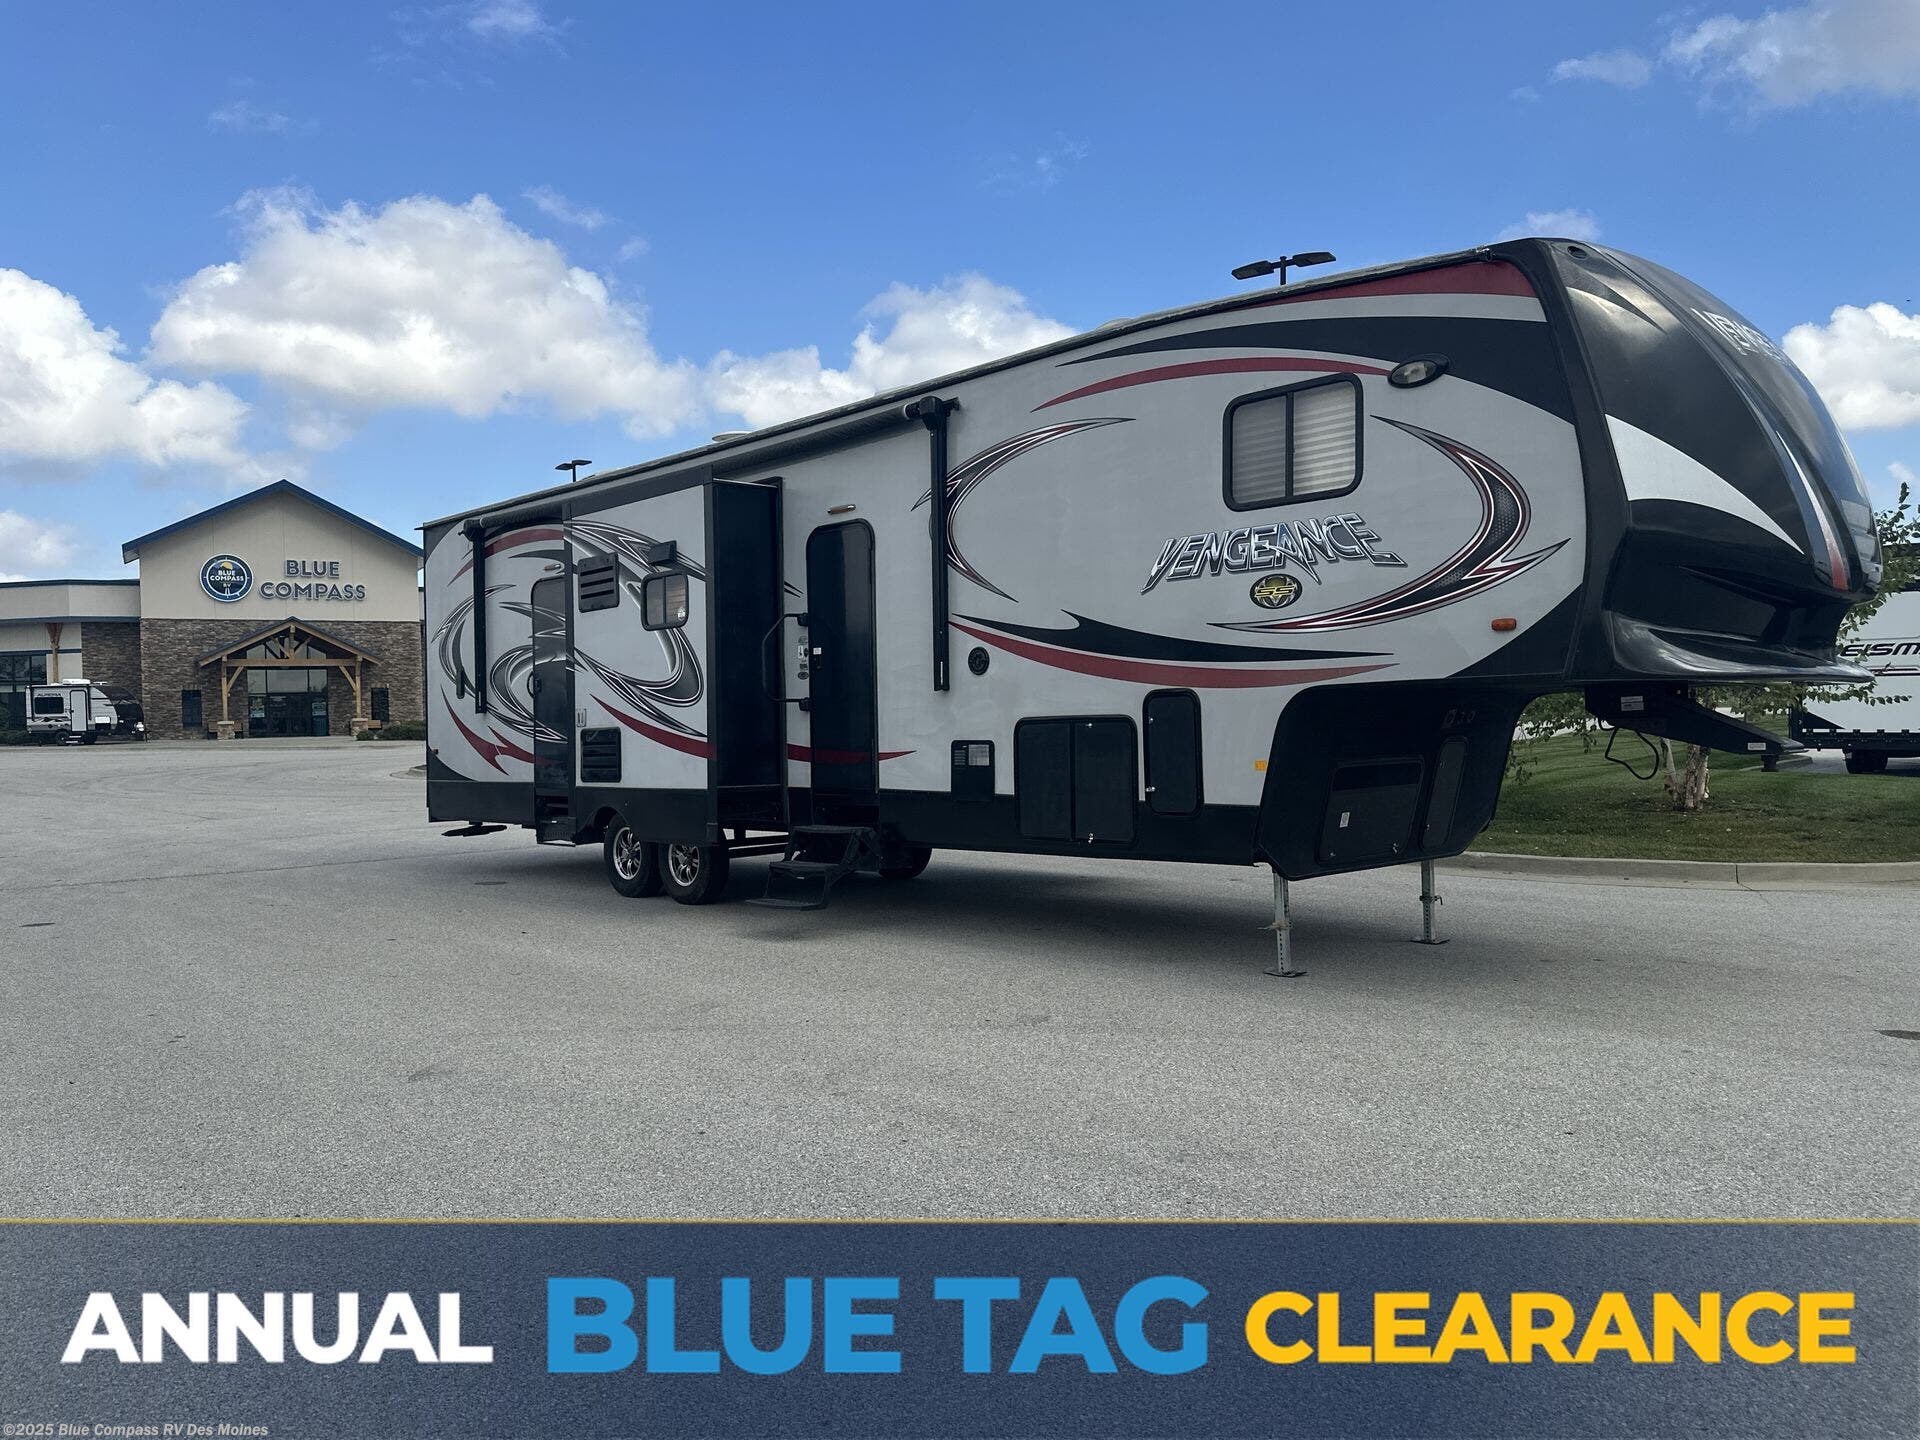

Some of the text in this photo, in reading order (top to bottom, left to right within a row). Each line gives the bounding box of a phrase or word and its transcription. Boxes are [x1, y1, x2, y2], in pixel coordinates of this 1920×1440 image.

[1140, 512, 1407, 595] VENGEANCE
[285, 559, 340, 578] BLUE
[259, 582, 366, 601] COMPASS
